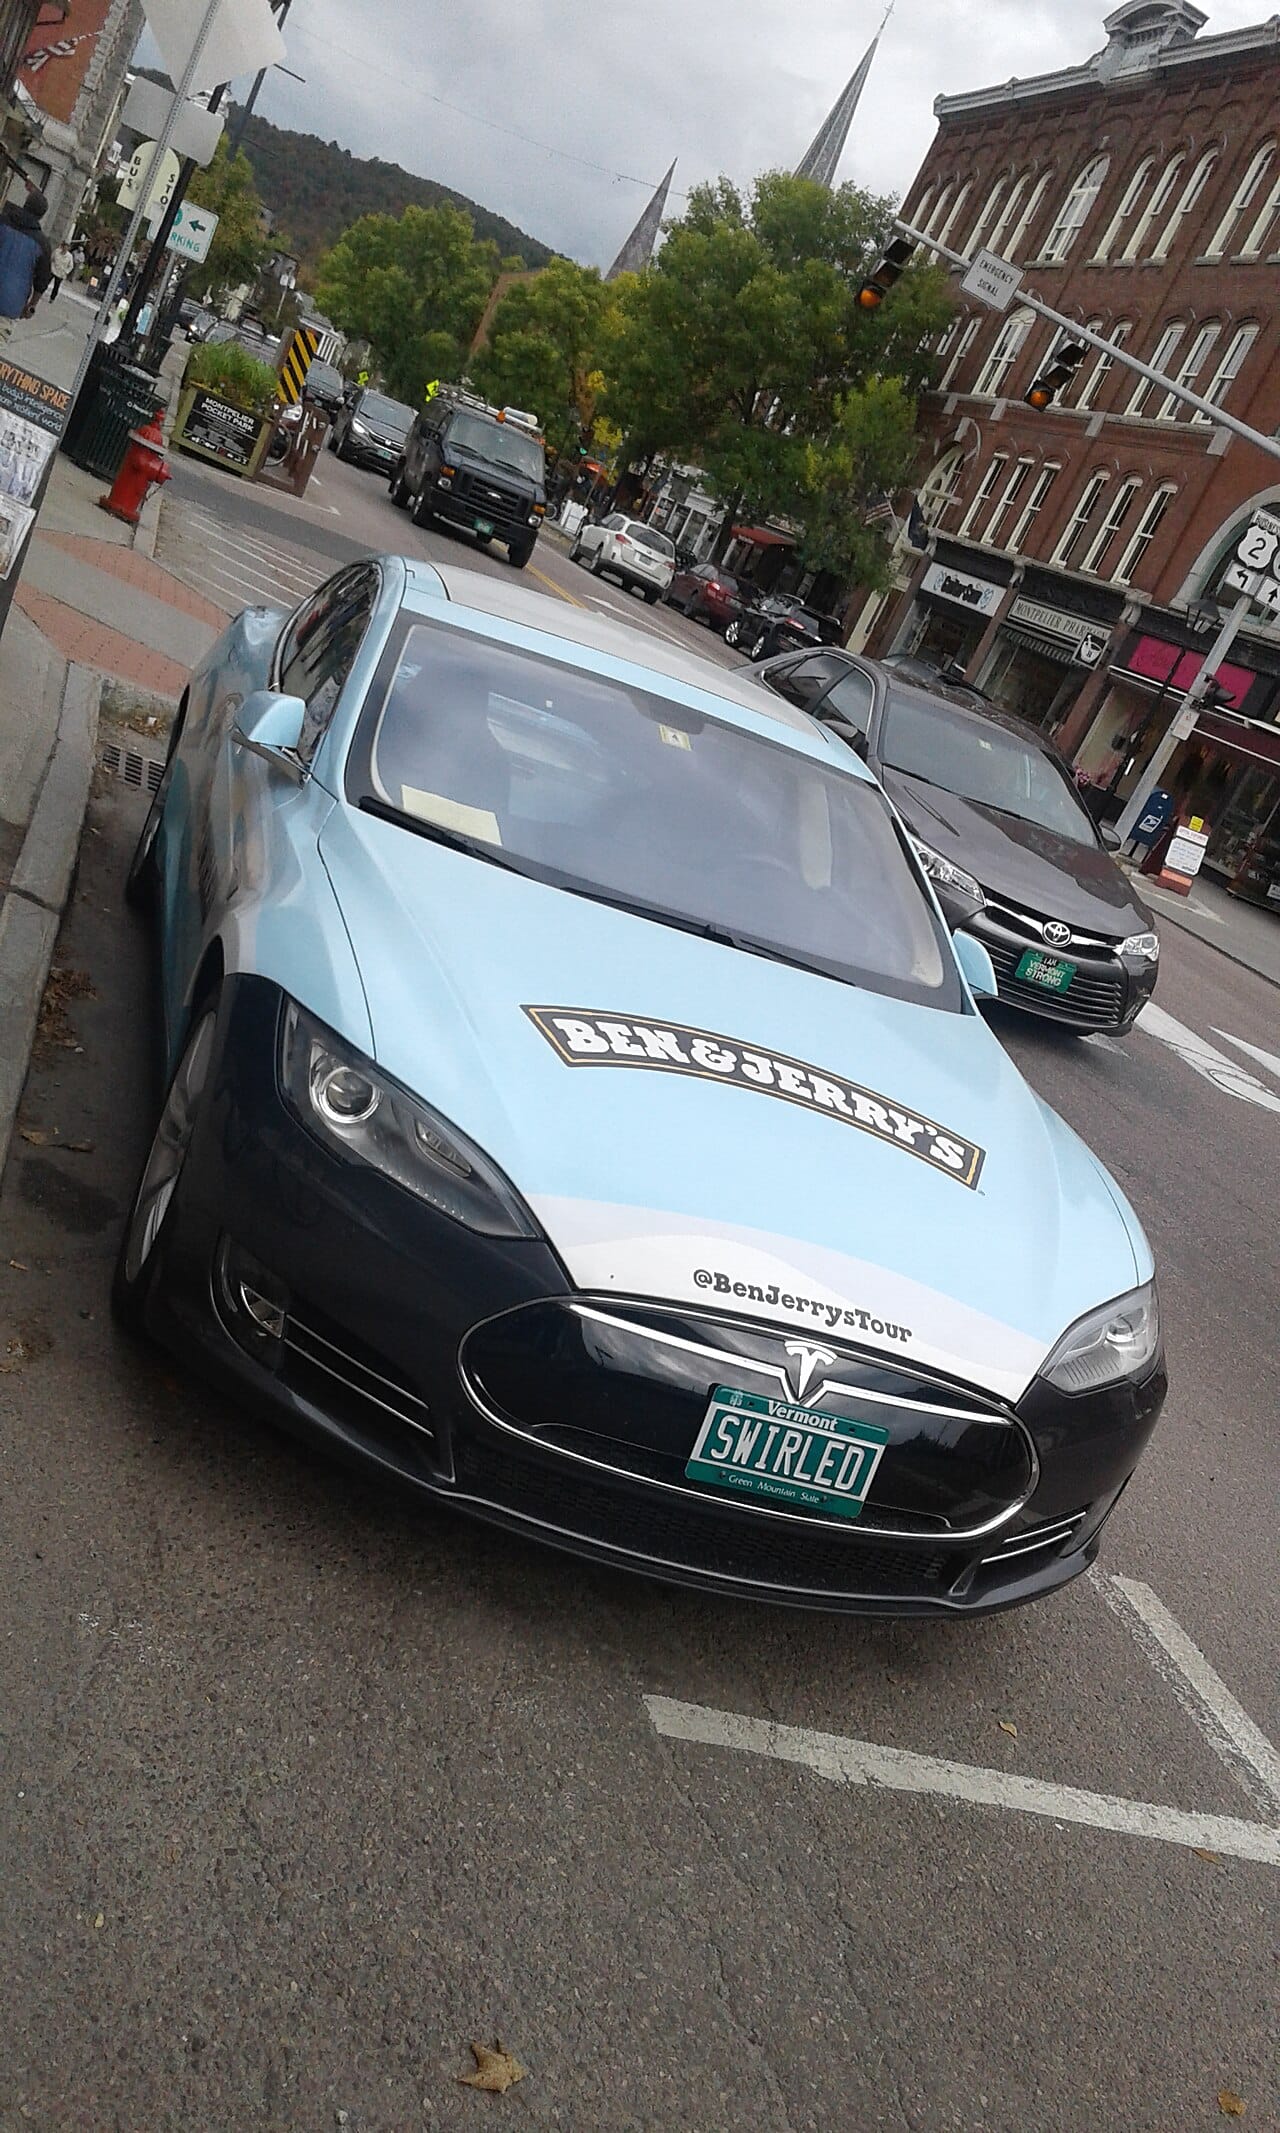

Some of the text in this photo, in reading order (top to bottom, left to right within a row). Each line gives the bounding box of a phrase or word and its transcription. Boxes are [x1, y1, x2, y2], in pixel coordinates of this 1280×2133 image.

[126, 155, 142, 188] BUS
[160, 173, 175, 206] STO
[170, 231, 200, 253] RKING
[979, 259, 1014, 285] EMERGENCY
[976, 278, 999, 297] SIGNAL
[0, 362, 72, 411] RYTHING SPACE
[41, 416, 63, 432] world
[201, 402, 233, 421] POCKET
[232, 417, 255, 433] PARK
[205, 397, 255, 425] MONTPELIER
[1247, 537, 1267, 561] 2
[1014, 602, 1062, 630] MONTPELIER
[1024, 967, 1062, 987] STRONG
[1030, 959, 1067, 979] VERMONT
[693, 1268, 913, 1343] @BenJerrysTour
[767, 1399, 839, 1432] Vermont
[710, 1414, 866, 1491] SWIRLED
[728, 1474, 820, 1504] Green Mountain State
